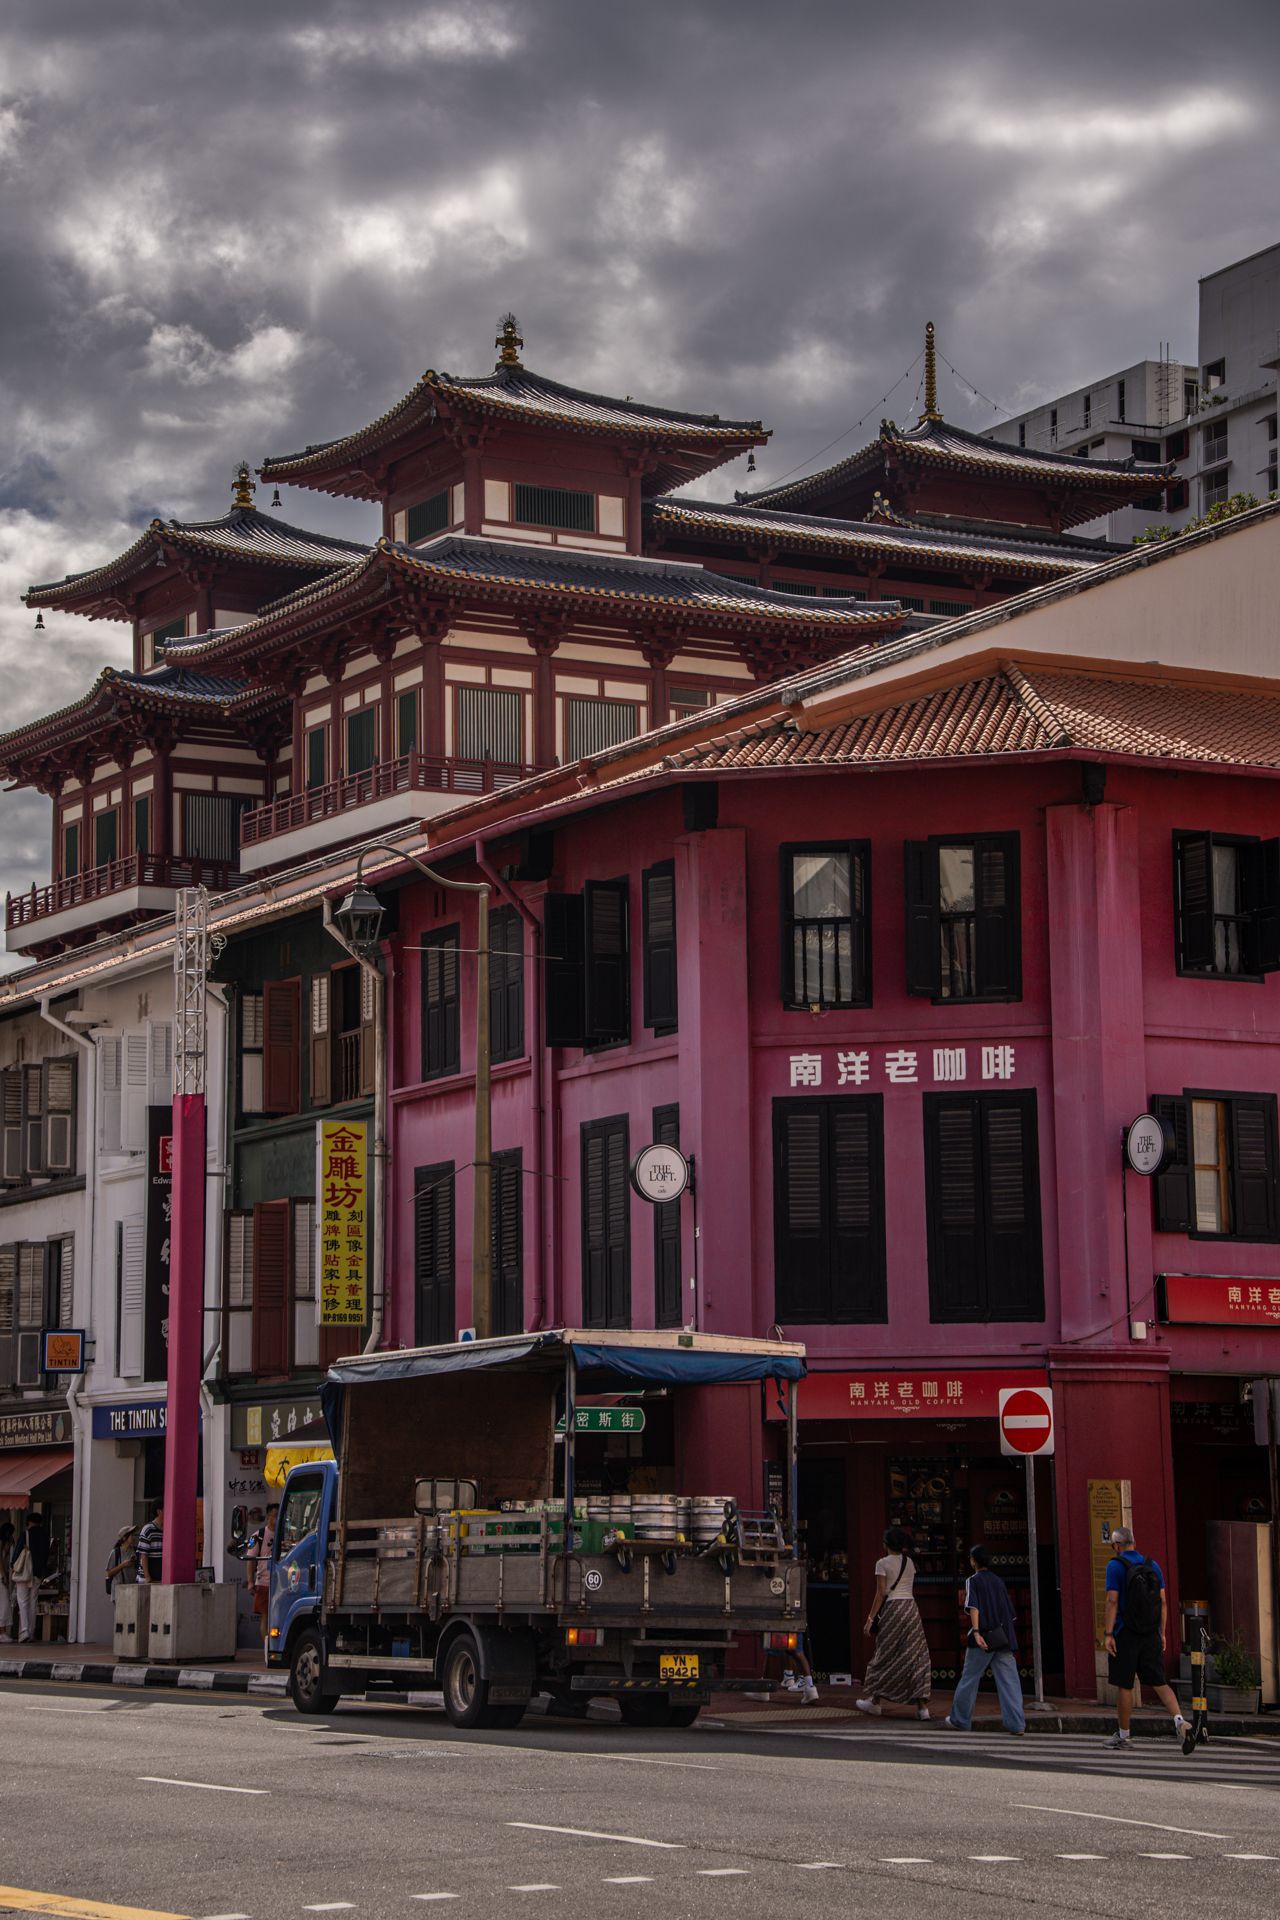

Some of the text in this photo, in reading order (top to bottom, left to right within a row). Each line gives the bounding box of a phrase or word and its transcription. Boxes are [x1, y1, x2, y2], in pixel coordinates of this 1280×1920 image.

[789, 1046, 1016, 1088] 南洋老咖啡
[1139, 1135, 1153, 1145] THE
[324, 1126, 363, 1209] 金雕坊
[651, 1164, 671, 1174] THE
[323, 1209, 363, 1223] 雕刻
[323, 1239, 363, 1252] 佛像
[323, 1268, 363, 1281] 家具
[322, 1282, 363, 1297] 古董
[322, 1297, 363, 1311] 修理
[1229, 1303, 1267, 1311] NANYANG
[49, 1358, 78, 1367] TINTIN
[849, 1380, 964, 1399] 南洋老咖啡
[110, 1410, 126, 1431] THE
[128, 1408, 157, 1430] TINTIN
[557, 1411, 635, 1428] 密斯街
[588, 1573, 600, 1584] 60
[772, 1580, 783, 1589] 24
[672, 1655, 687, 1666] YN
